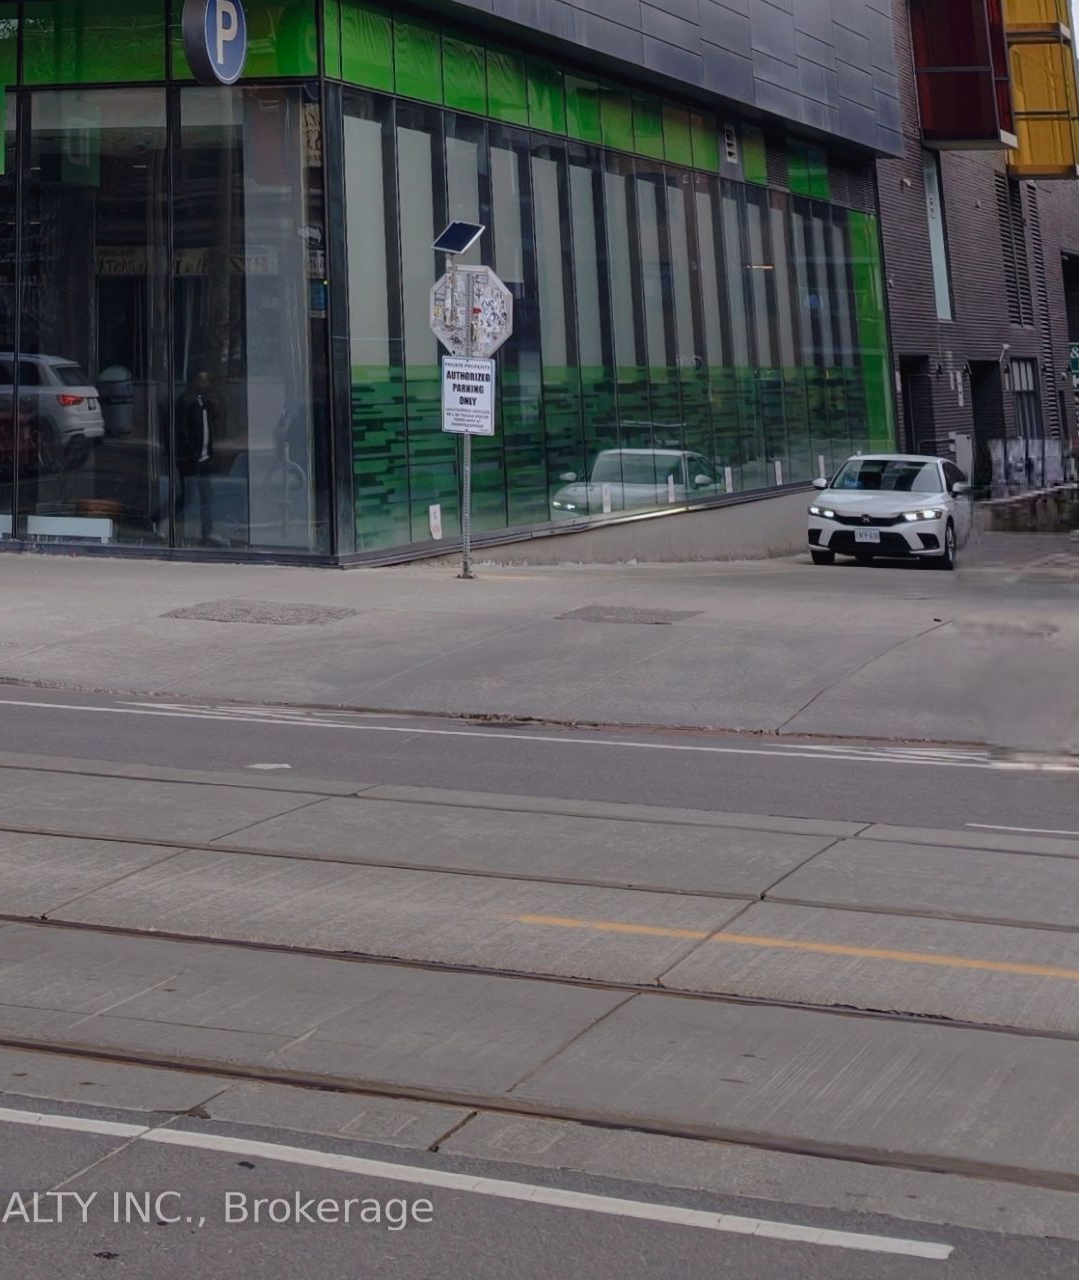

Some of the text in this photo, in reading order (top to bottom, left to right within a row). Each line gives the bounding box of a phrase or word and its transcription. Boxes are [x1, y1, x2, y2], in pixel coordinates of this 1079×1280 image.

[446, 370, 491, 382] AUTHORIZED
[452, 383, 484, 394] PARKING
[459, 396, 477, 406] ONLY
